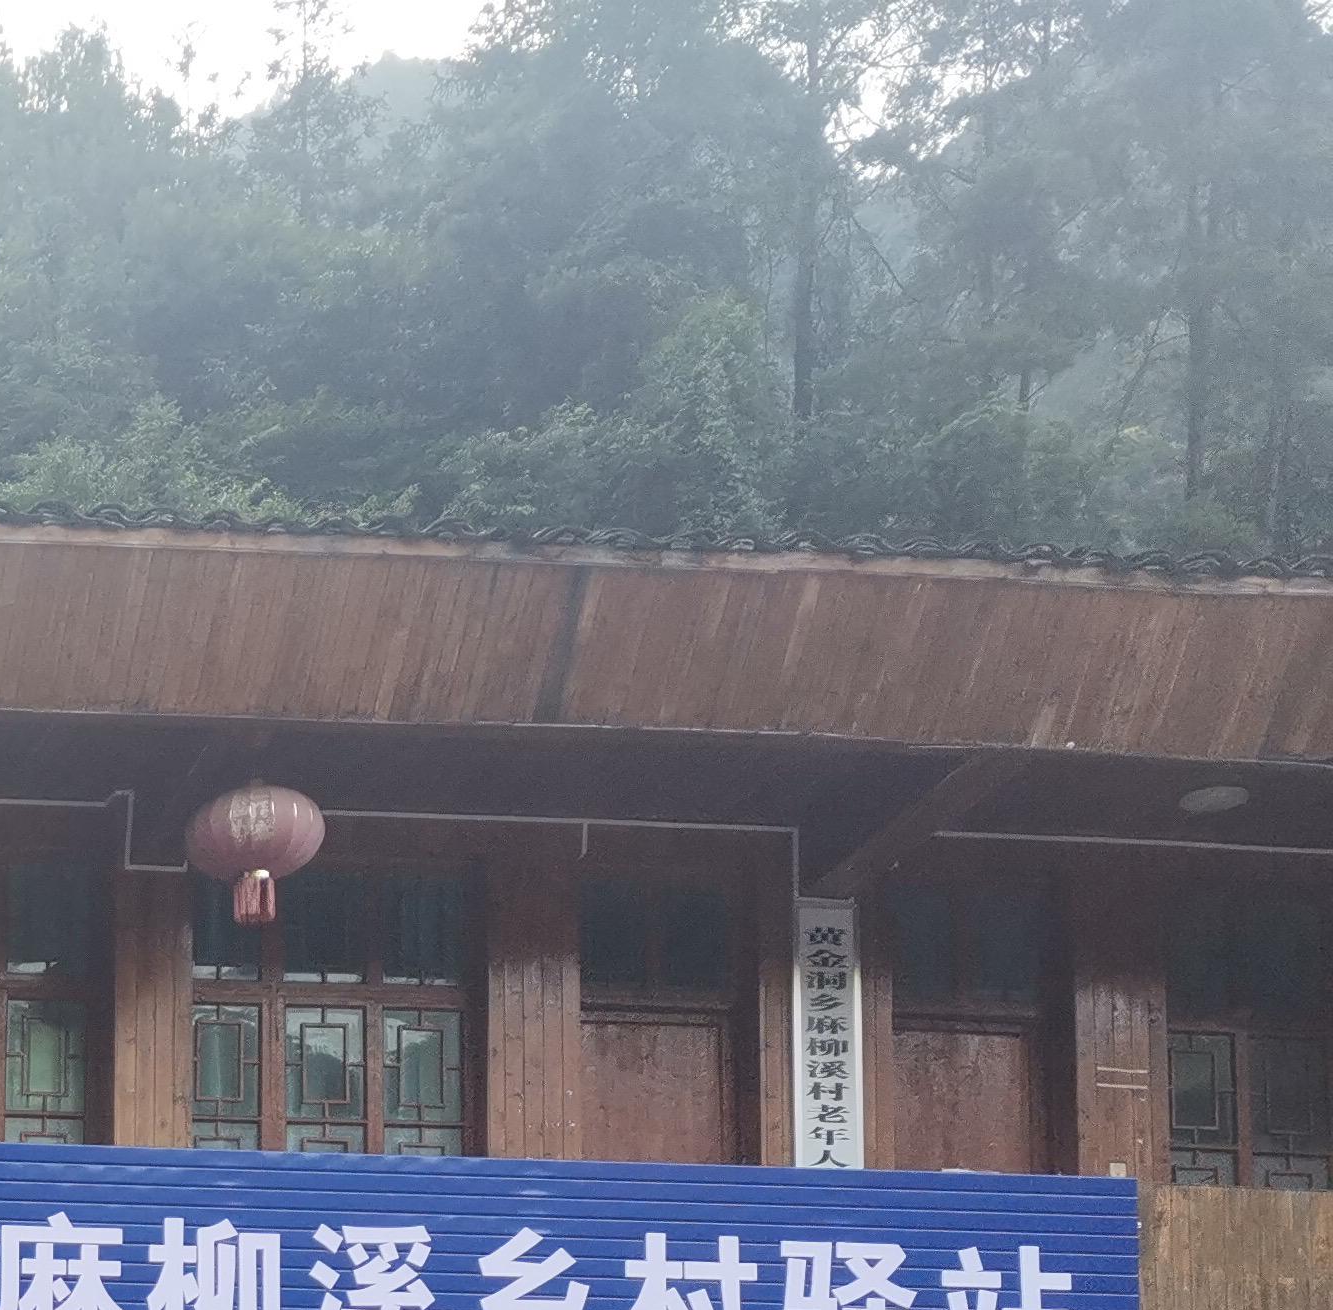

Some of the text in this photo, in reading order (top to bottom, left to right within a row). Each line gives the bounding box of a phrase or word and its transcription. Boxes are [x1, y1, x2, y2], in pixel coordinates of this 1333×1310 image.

[805, 926, 851, 1168] 黄金洞乡麻柳溪村老年人
